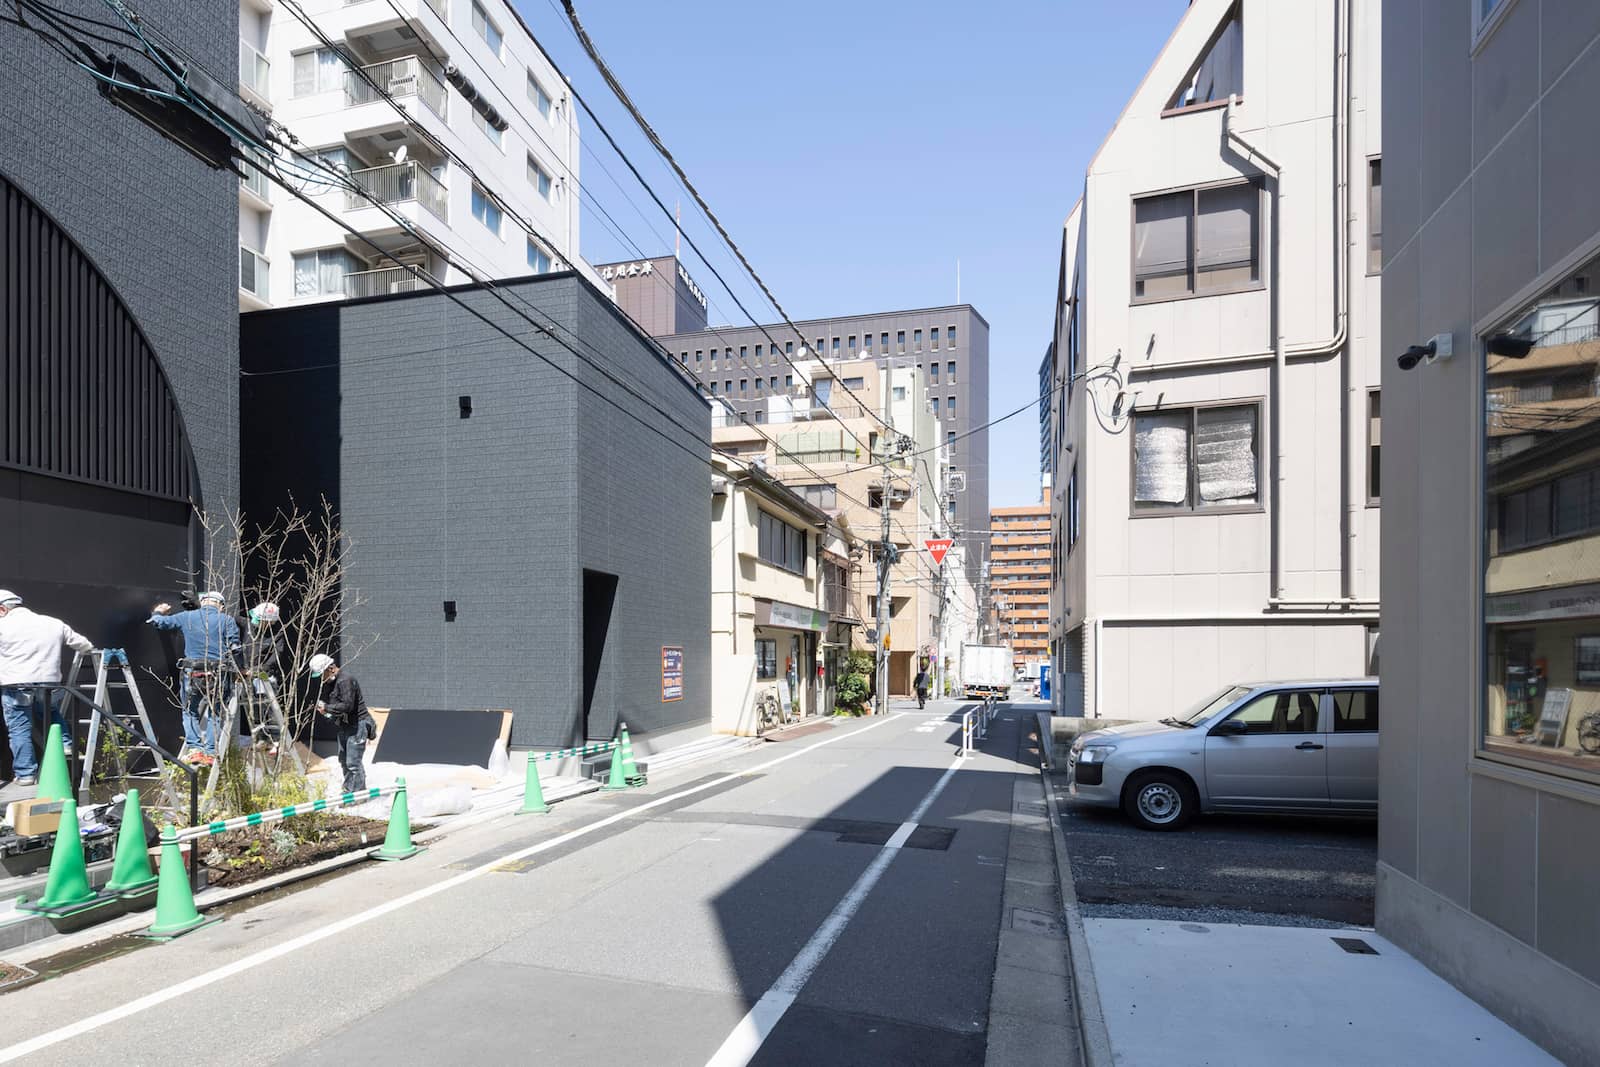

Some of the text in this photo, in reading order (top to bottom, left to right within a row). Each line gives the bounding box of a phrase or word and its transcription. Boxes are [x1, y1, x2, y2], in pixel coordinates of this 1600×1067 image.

[595, 261, 653, 280] 信用金庫
[930, 543, 947, 551] 止まれ
